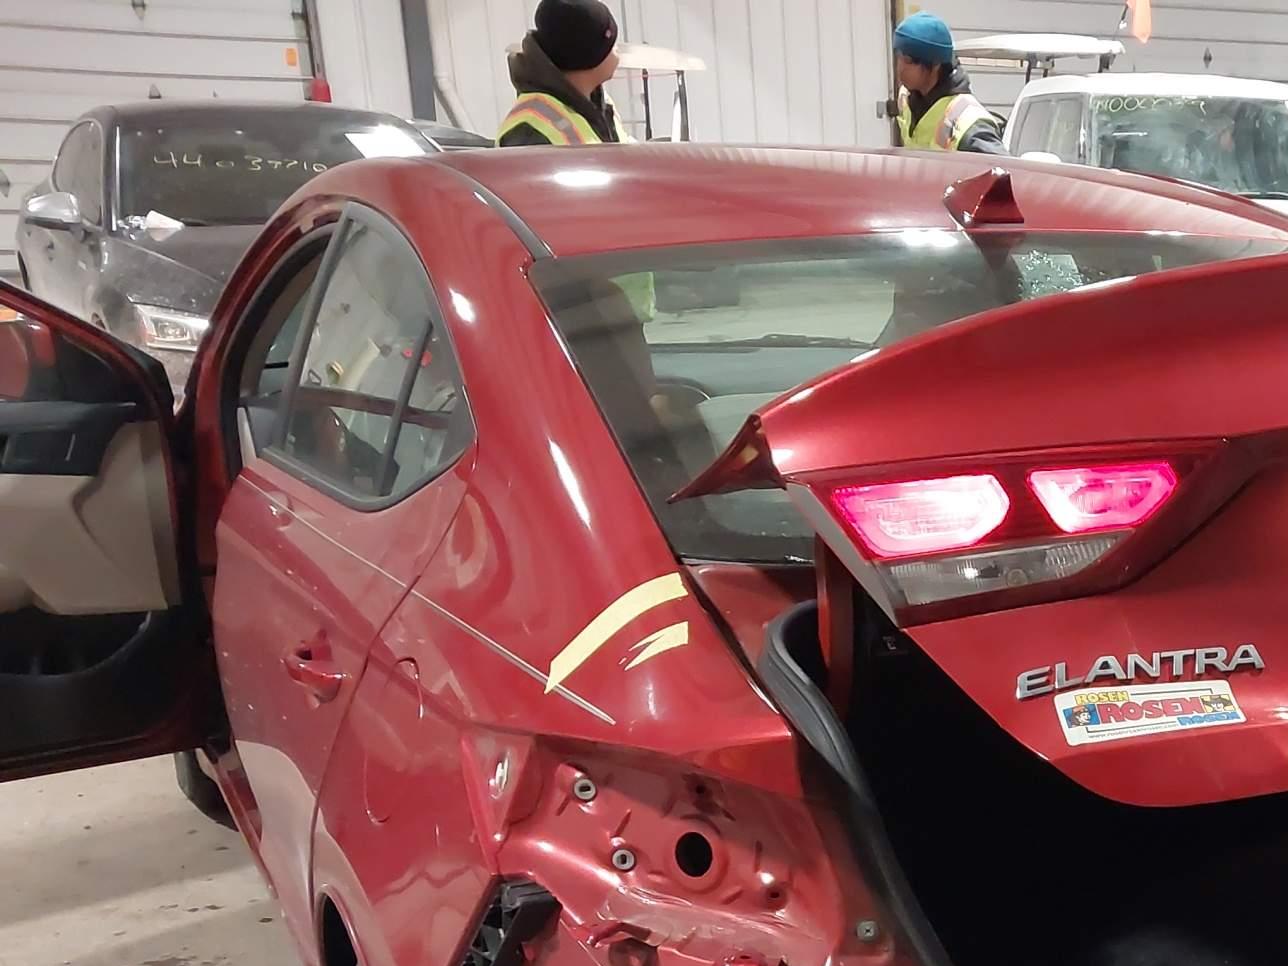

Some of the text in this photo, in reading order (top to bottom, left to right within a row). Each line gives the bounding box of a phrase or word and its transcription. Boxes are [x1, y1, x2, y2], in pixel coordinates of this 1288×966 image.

[1016, 644, 1266, 700] ELANTRA
[1074, 690, 1130, 705] ROSEN
[1097, 697, 1205, 725] ROSEN
[1177, 711, 1241, 727] ROSEN
